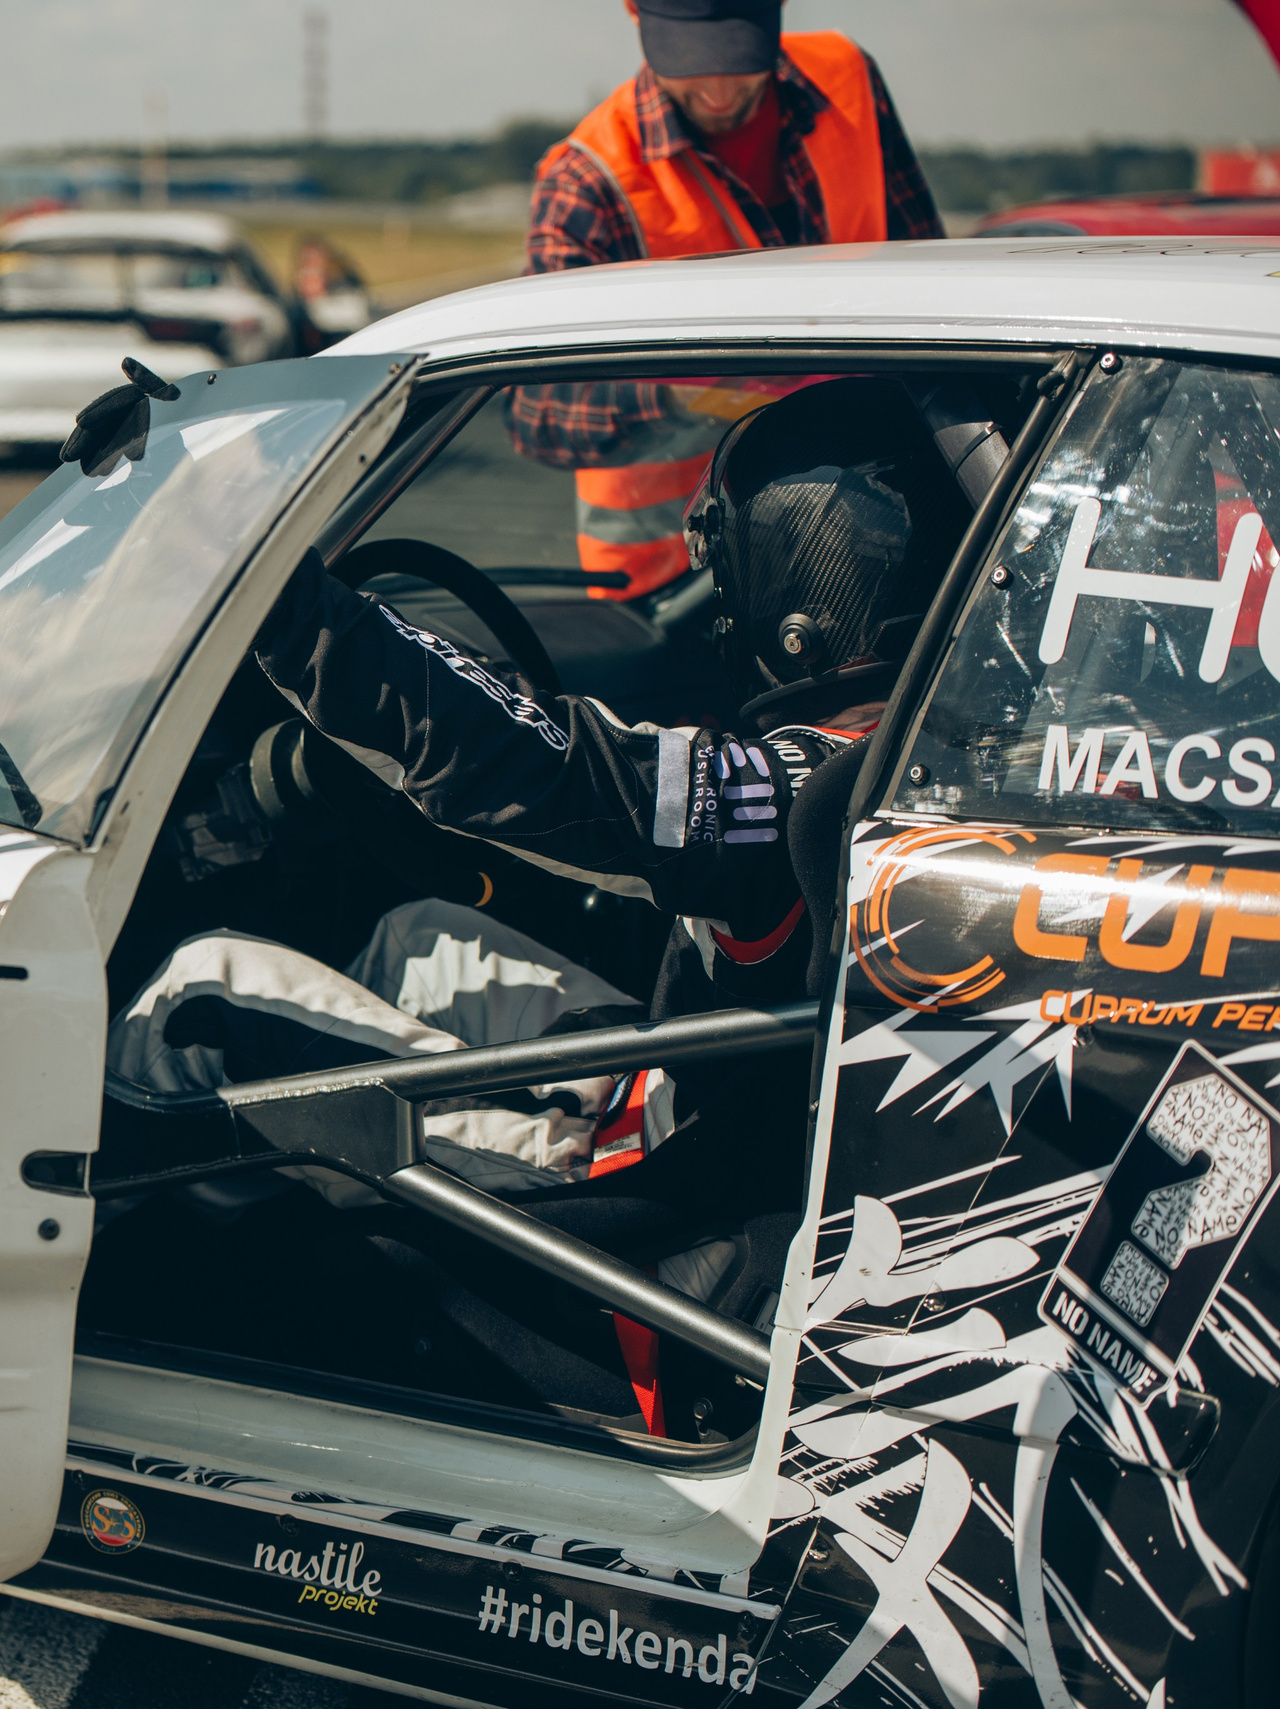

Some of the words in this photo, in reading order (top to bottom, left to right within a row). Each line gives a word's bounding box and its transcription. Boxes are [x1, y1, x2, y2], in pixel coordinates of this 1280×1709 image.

[1038, 497, 1280, 685] H
[767, 740, 807, 762] NO
[786, 767, 813, 798] N
[1037, 724, 1280, 806] MACS
[690, 749, 709, 842] USHROOM
[703, 745, 718, 842] ERONIC
[1039, 989, 1204, 1027] CUPRUM
[1052, 1290, 1090, 1336] NO
[1086, 1321, 1158, 1394] NAME
[253, 1541, 383, 1597] nastile
[297, 1585, 379, 1616] projekt
[478, 1585, 758, 1695] #ridekenda
